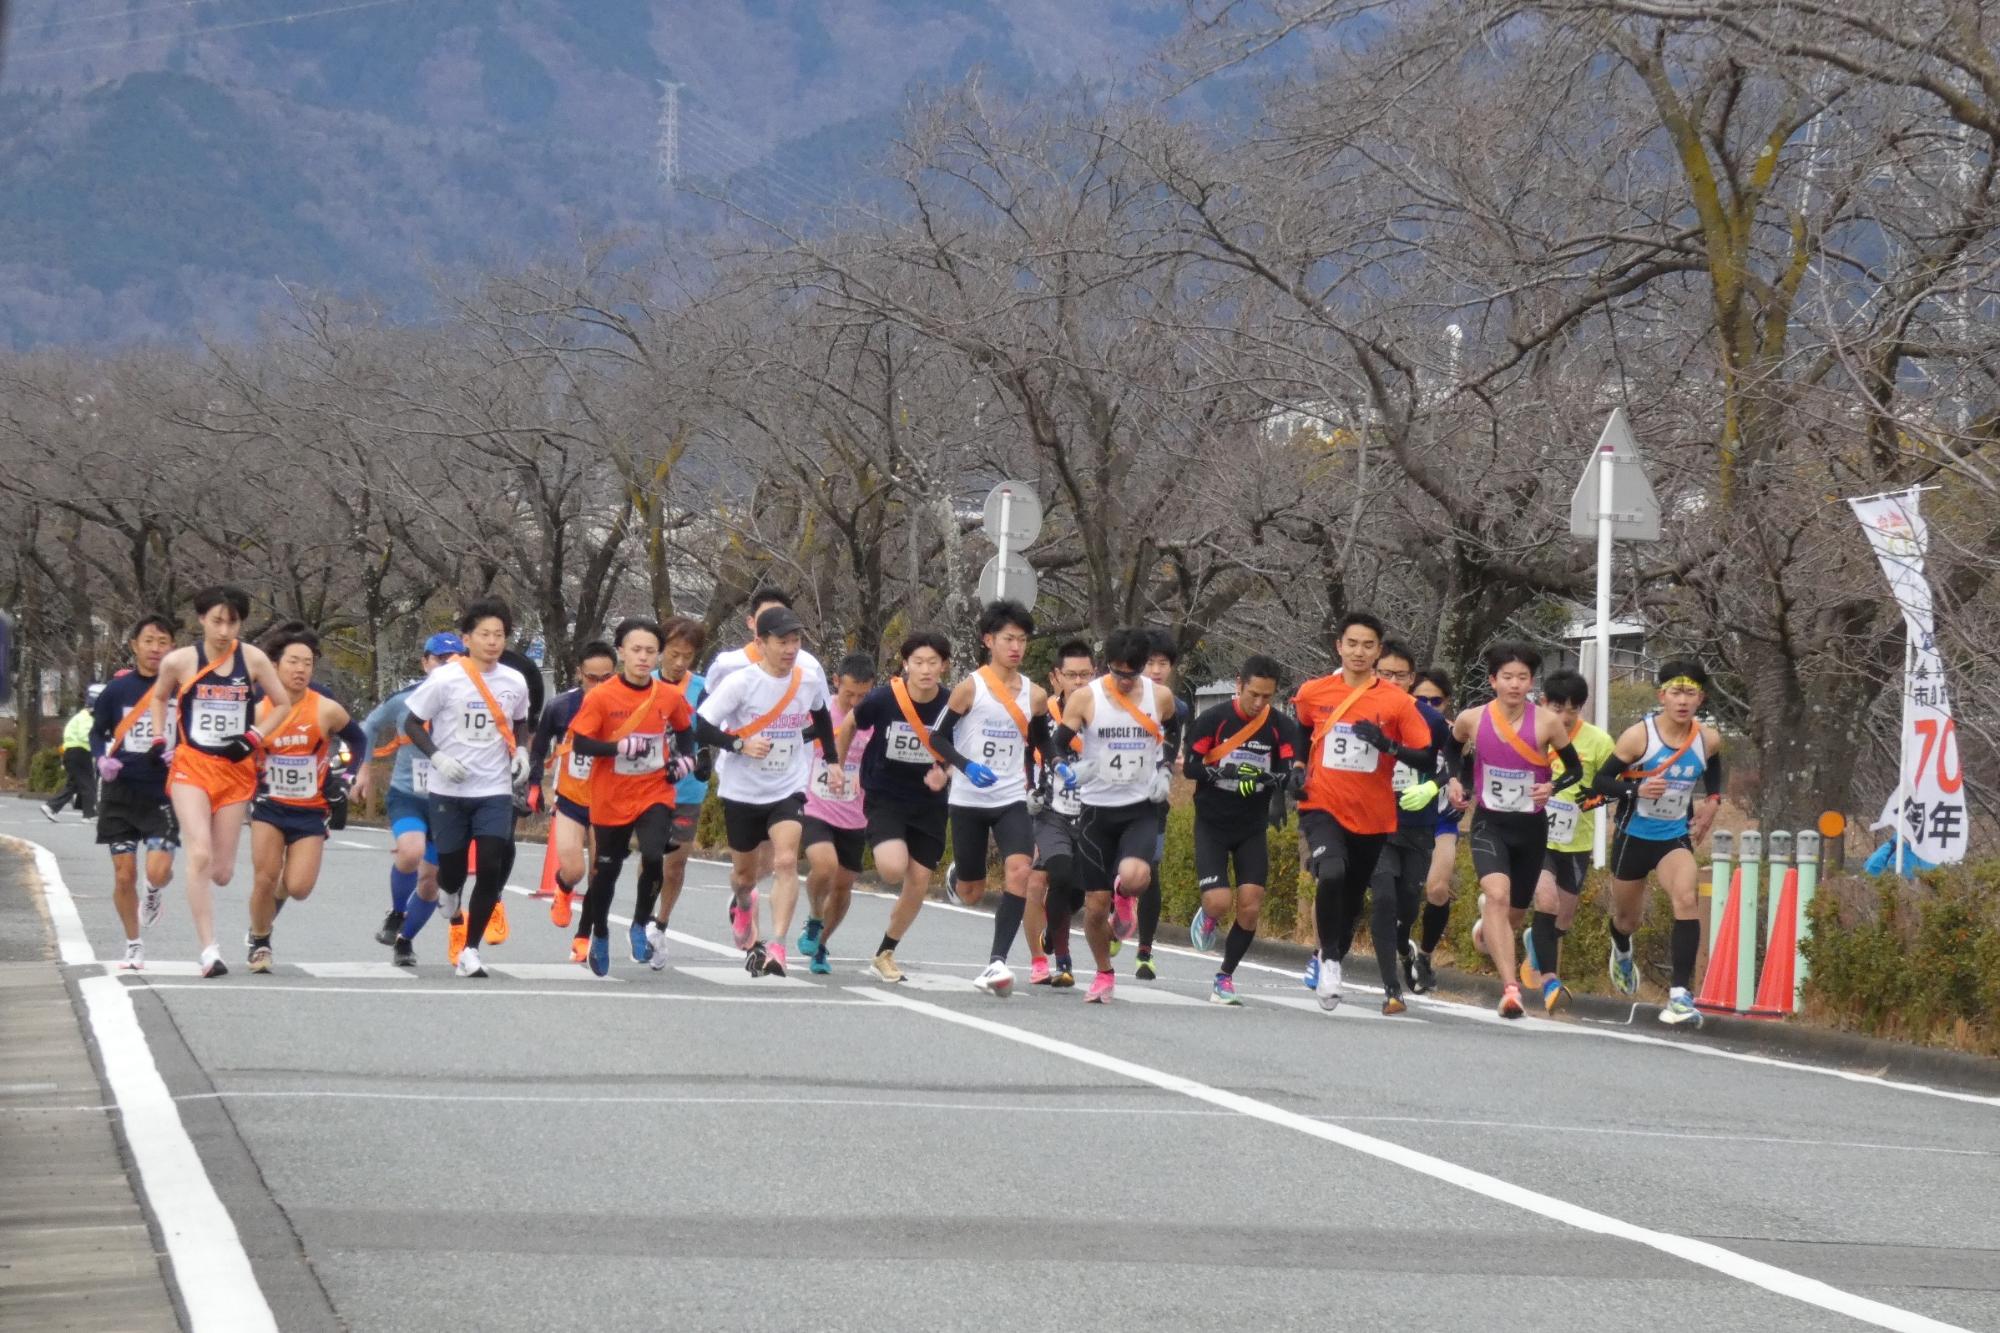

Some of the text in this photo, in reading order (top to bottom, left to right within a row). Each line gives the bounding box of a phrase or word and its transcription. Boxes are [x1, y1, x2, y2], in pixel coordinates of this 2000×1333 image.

[130, 721, 173, 738] 1221
[200, 713, 239, 732] 28-1
[464, 713, 495, 729] 10-
[1098, 727, 1130, 738] MUSCLE
[895, 735, 921, 750] 50
[983, 741, 1013, 757] 6-1
[1334, 737, 1369, 756] 3-1
[1110, 754, 1144, 770] 4-1
[1915, 719, 1964, 794] 70
[270, 766, 312, 784] 119-1
[1491, 781, 1525, 798] 2-1
